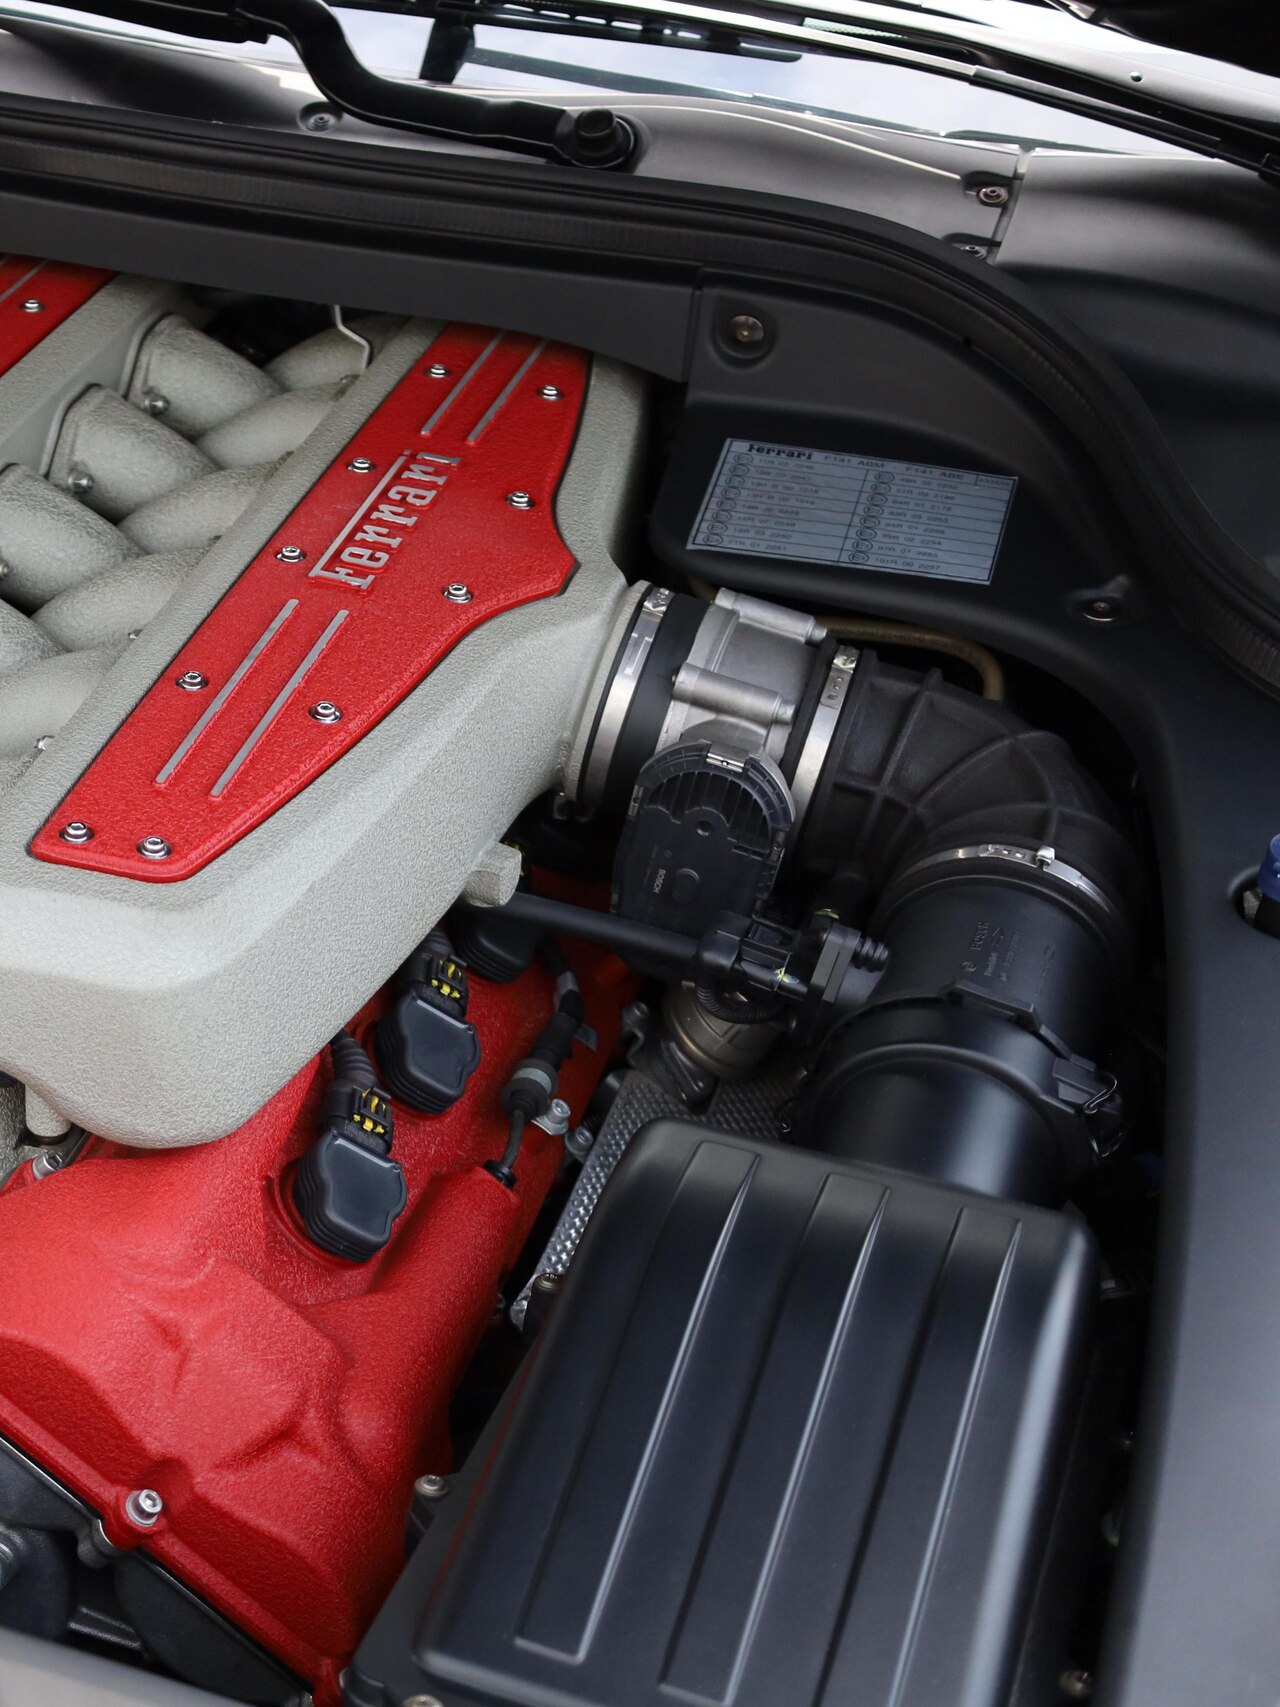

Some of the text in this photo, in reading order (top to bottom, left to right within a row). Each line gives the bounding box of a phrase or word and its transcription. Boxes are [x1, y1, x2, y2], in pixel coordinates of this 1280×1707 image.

[746, 443, 813, 460] Ferrari
[308, 449, 463, 590] Ferrari
[652, 868, 666, 893] BOSCH
